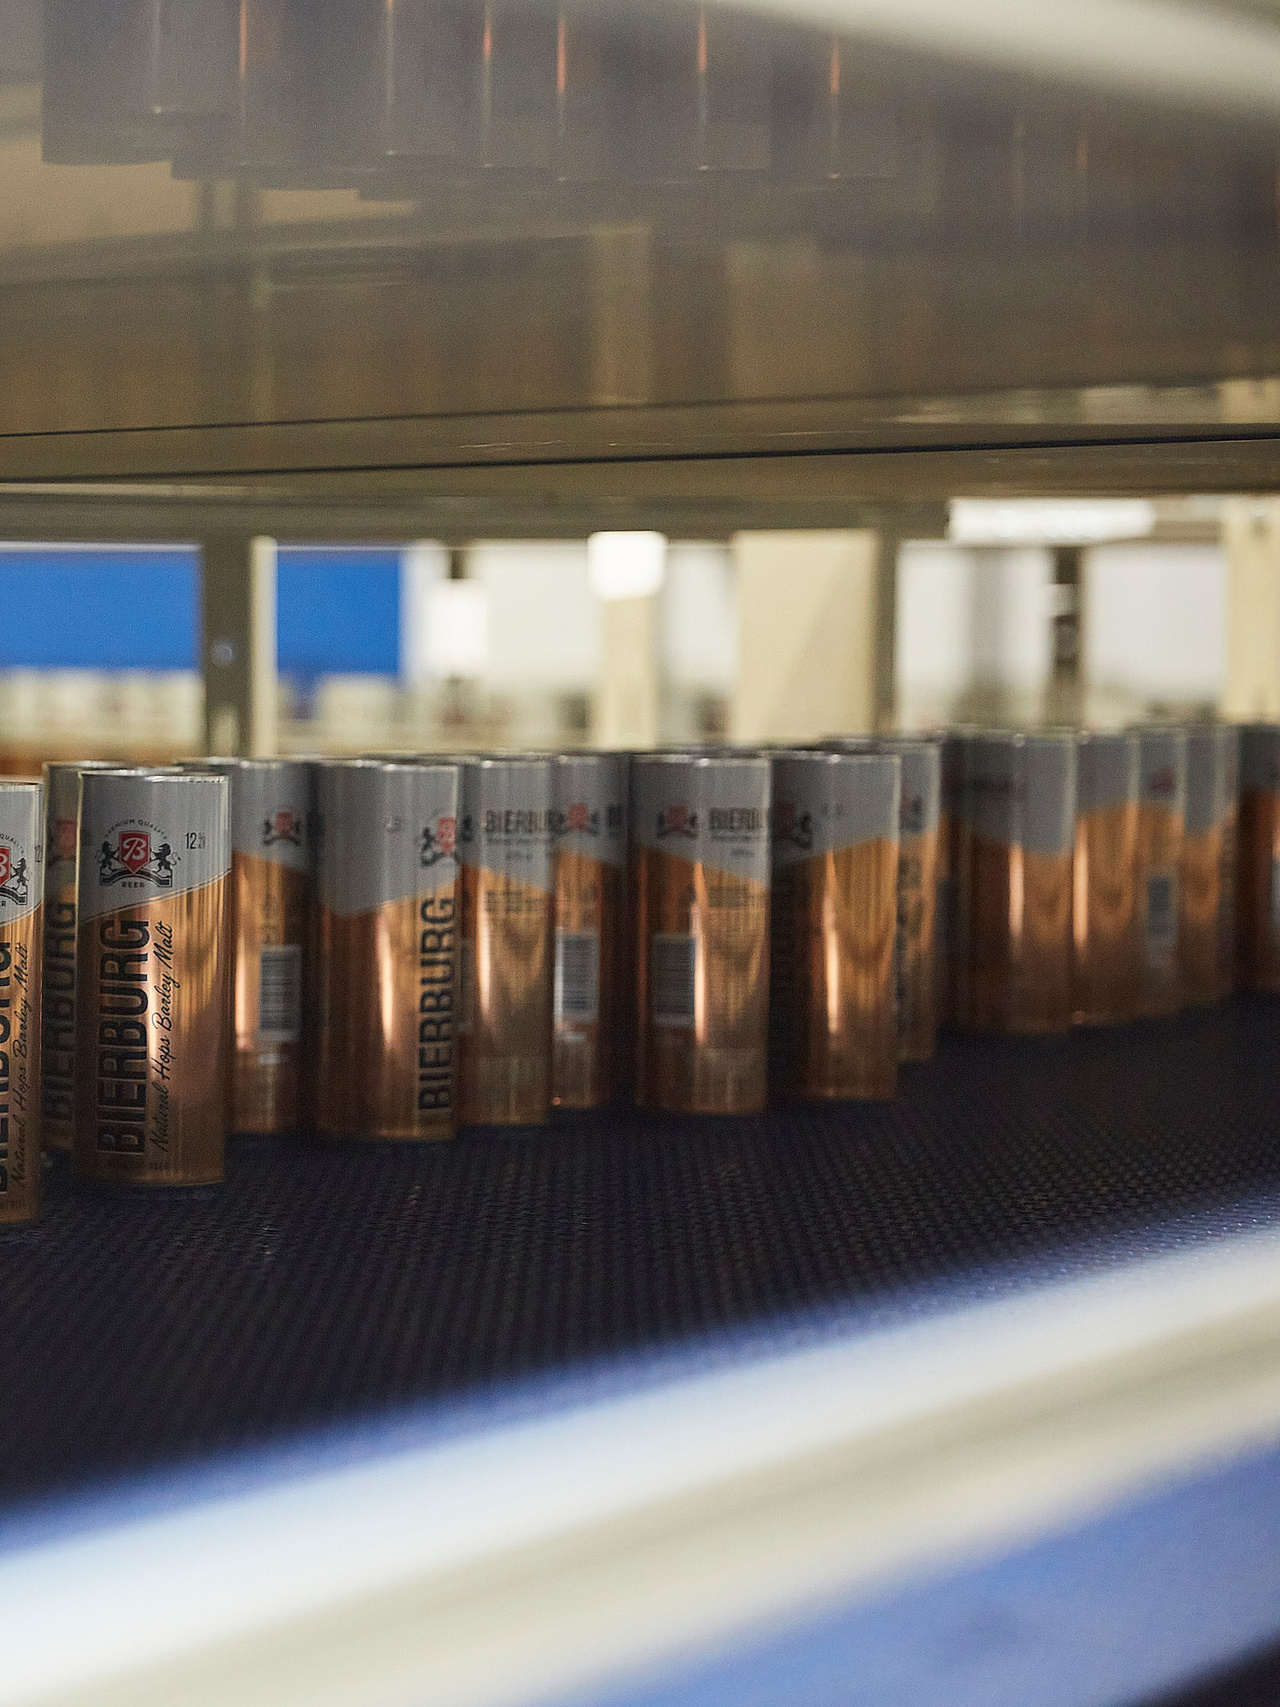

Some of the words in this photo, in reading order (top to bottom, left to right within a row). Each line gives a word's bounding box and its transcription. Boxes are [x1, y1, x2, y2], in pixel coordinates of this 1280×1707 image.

[122, 881, 145, 889] BEER
[12, 941, 30, 993] Malt
[153, 920, 174, 970] Malt
[12, 997, 33, 1059] Barley
[152, 973, 181, 1032] Barley
[419, 898, 455, 1110] BIERBURG
[96, 919, 150, 1153] BIERBURG
[152, 1036, 176, 1081] Hops
[12, 1066, 30, 1112] Hops
[150, 1081, 169, 1153] Natural
[11, 1114, 28, 1189] Natural
